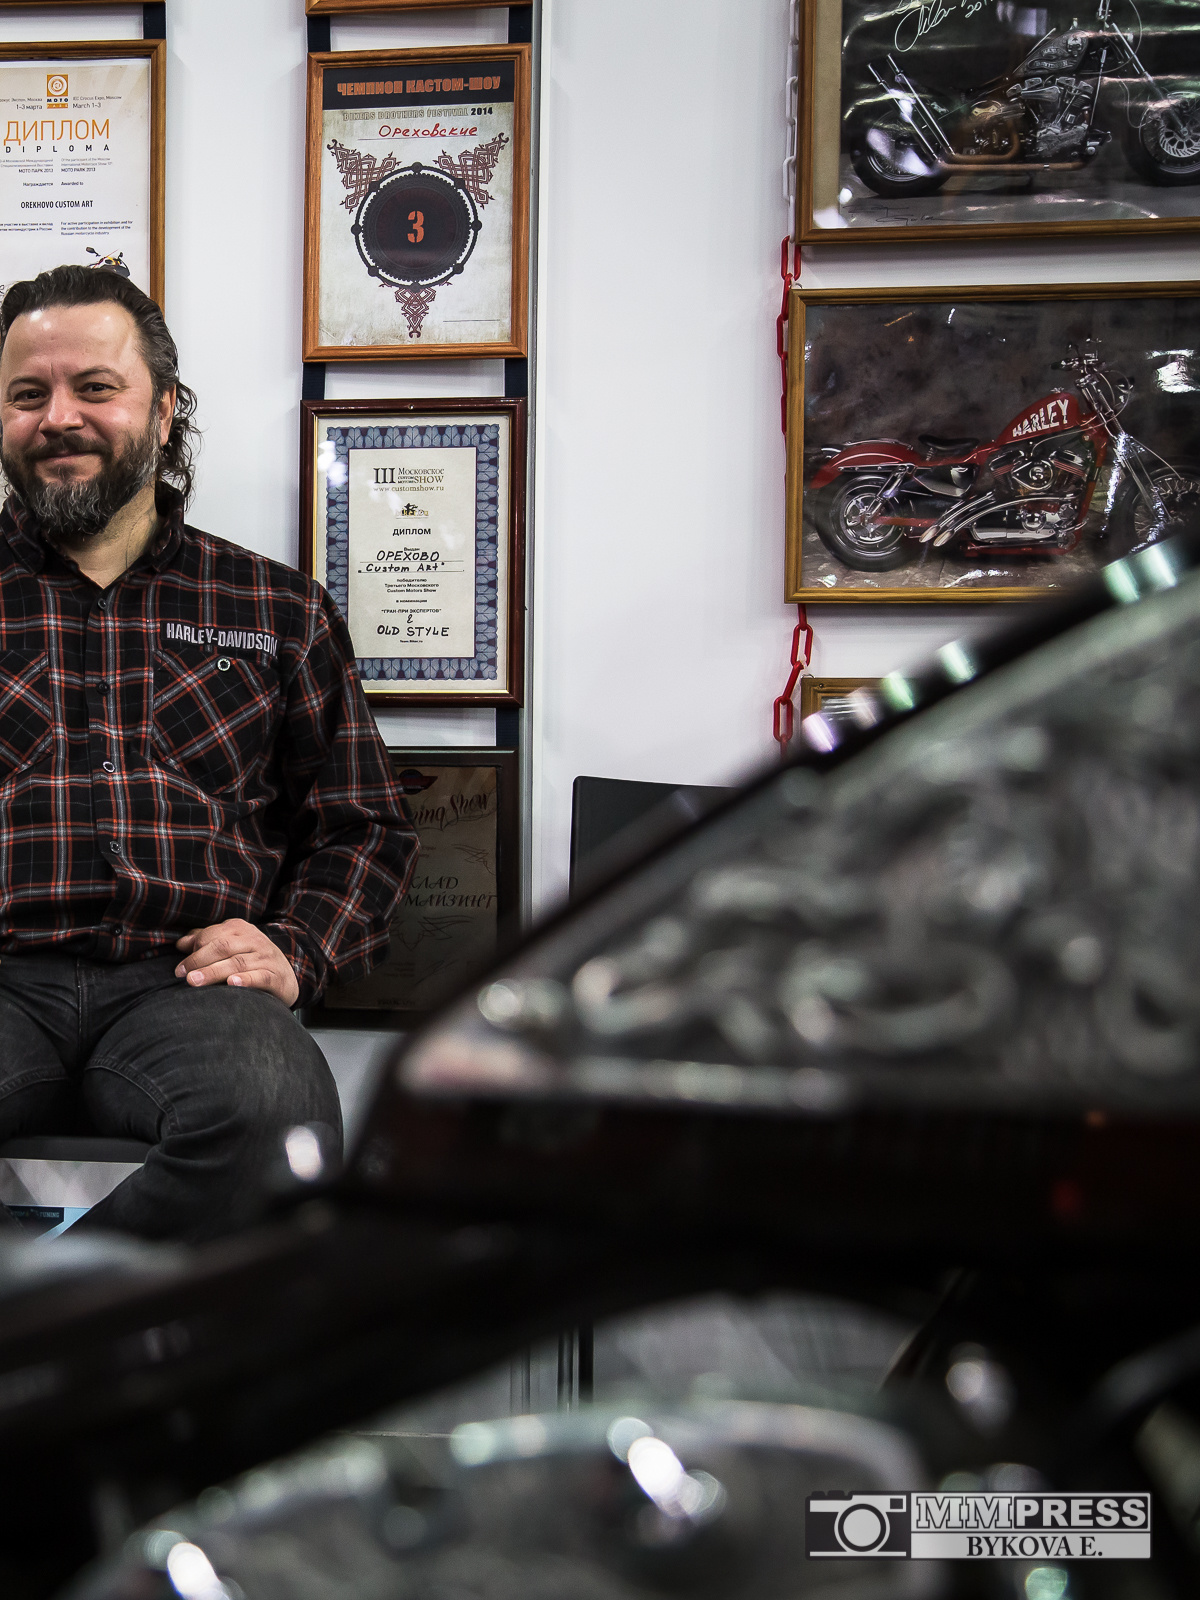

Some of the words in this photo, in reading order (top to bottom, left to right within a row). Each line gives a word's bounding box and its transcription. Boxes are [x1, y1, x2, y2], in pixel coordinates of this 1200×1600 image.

[337, 80, 403, 96] ЧЕМПИОН
[406, 76, 501, 94] КАСТОМ-ШОУ
[343, 112, 376, 121] BIKERS
[378, 110, 425, 120] BROTHERS
[427, 108, 469, 118] FESTIVAL
[470, 106, 493, 116] 2014
[4, 118, 110, 146] ДИПЛОМ
[378, 122, 478, 138] Ореховские
[6, 144, 110, 153] DIPLOMA
[55, 201, 80, 209] CUSTOM
[82, 200, 94, 208] ART
[407, 210, 425, 243] 3
[1012, 399, 1069, 438] HARLEY
[414, 476, 444, 484] SHOW
[392, 528, 431, 536] ДИПЛОМ
[376, 550, 440, 561] ОРЕХОВО
[377, 625, 400, 636] OLD
[407, 626, 450, 637] STYLE
[166, 622, 278, 656] HARLEY-DAVIDSON
